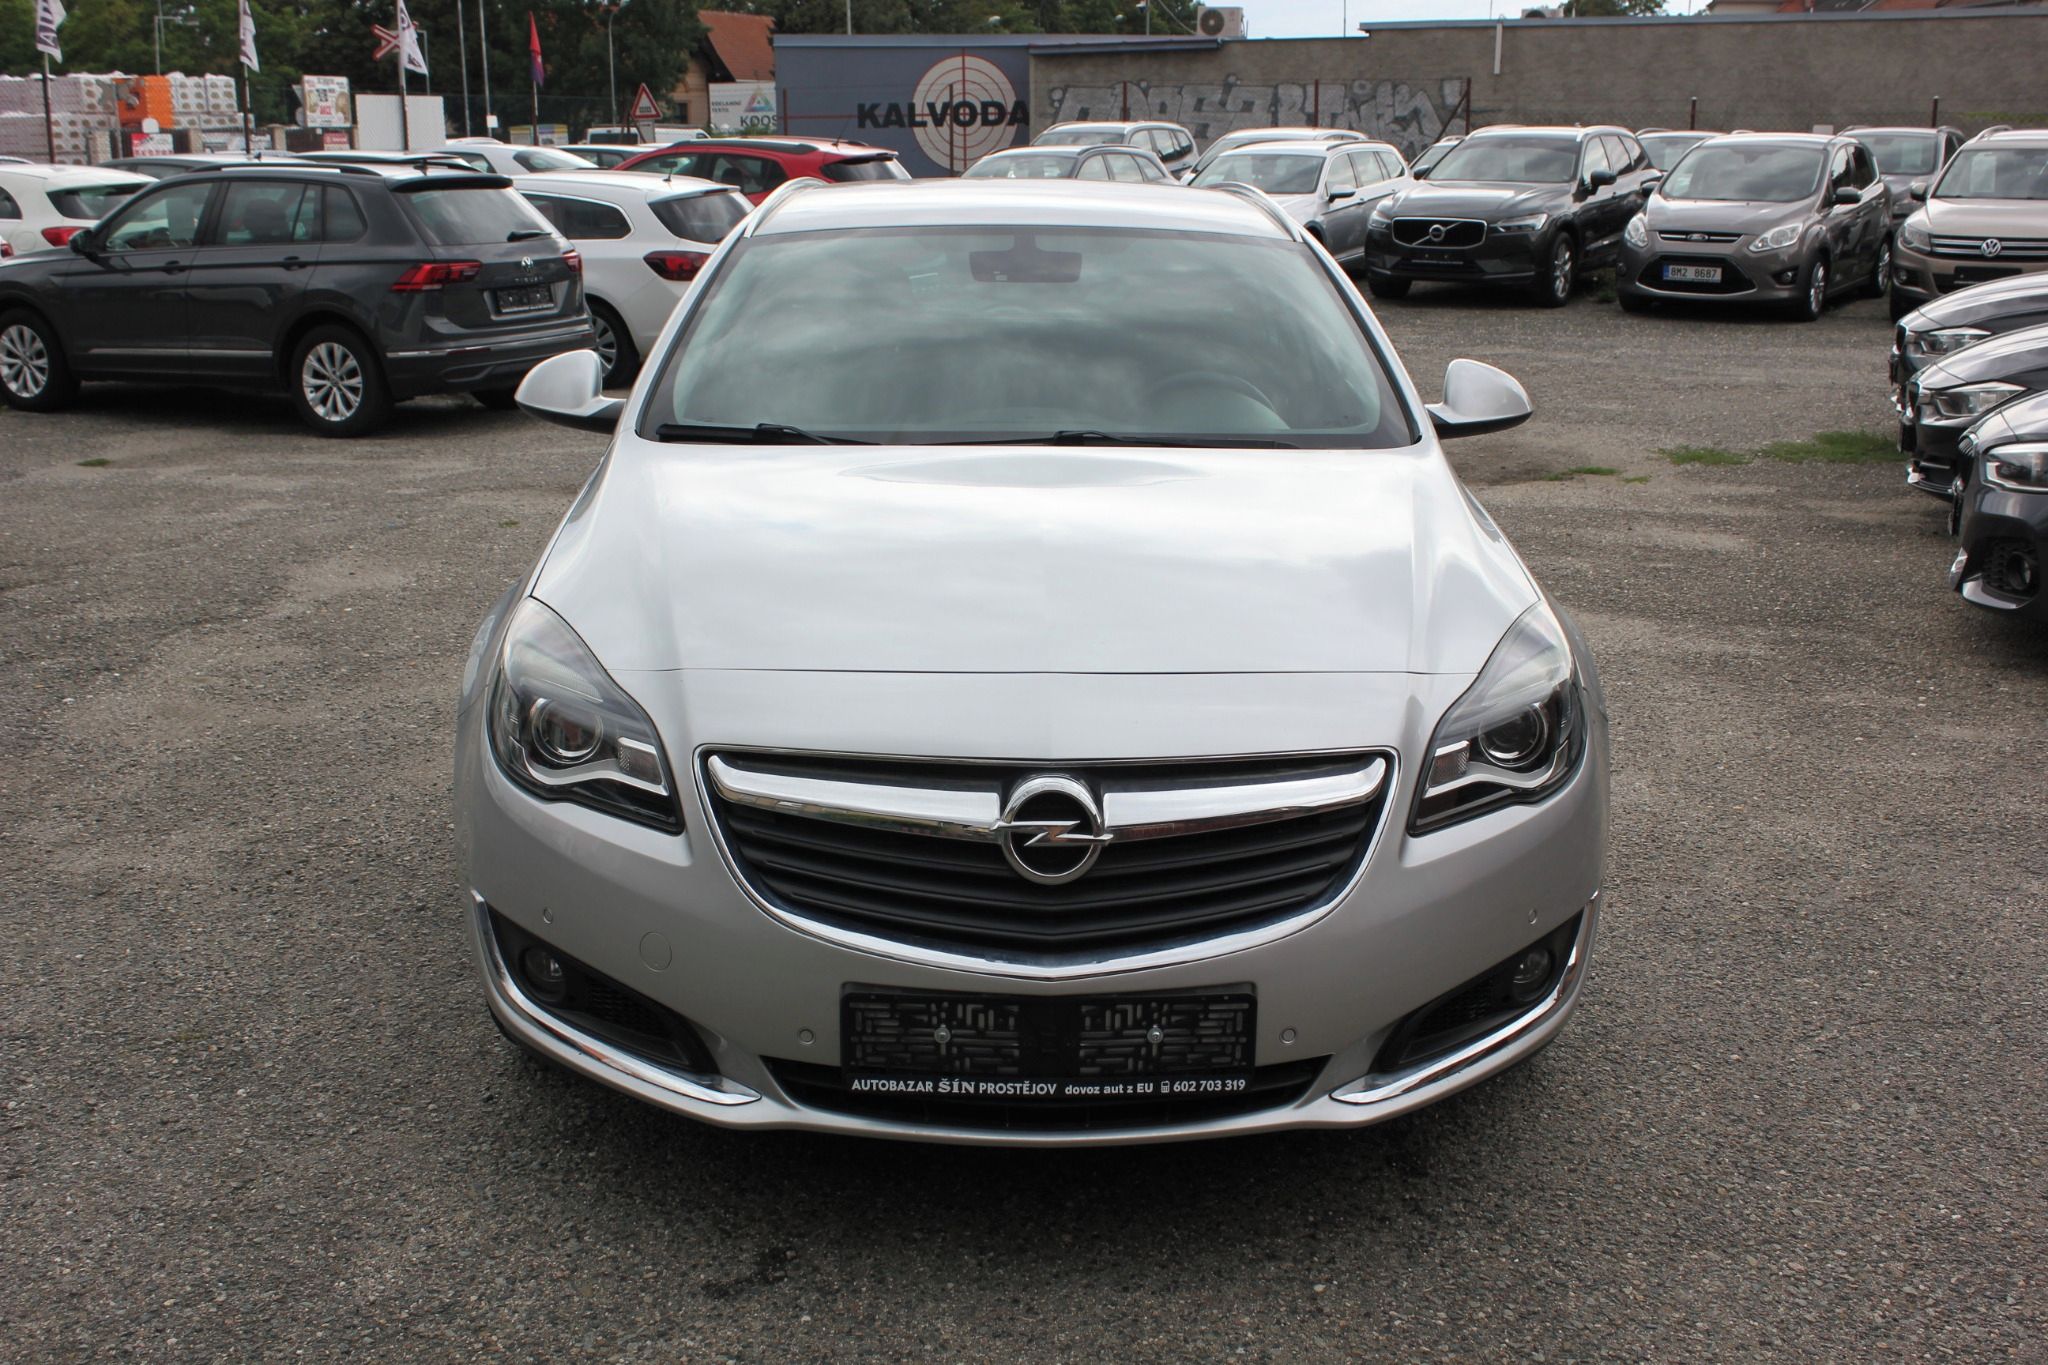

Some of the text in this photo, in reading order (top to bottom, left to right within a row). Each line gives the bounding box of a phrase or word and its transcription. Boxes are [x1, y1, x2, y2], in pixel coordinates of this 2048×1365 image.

[857, 100, 1029, 128] KALVODA
[1671, 267, 1717, 279] 8M2 8687
[851, 1077, 1246, 1095] AUTOBAZAR ŠÍN PROSTĚJOV dovoz aut z EU 602 703 319
